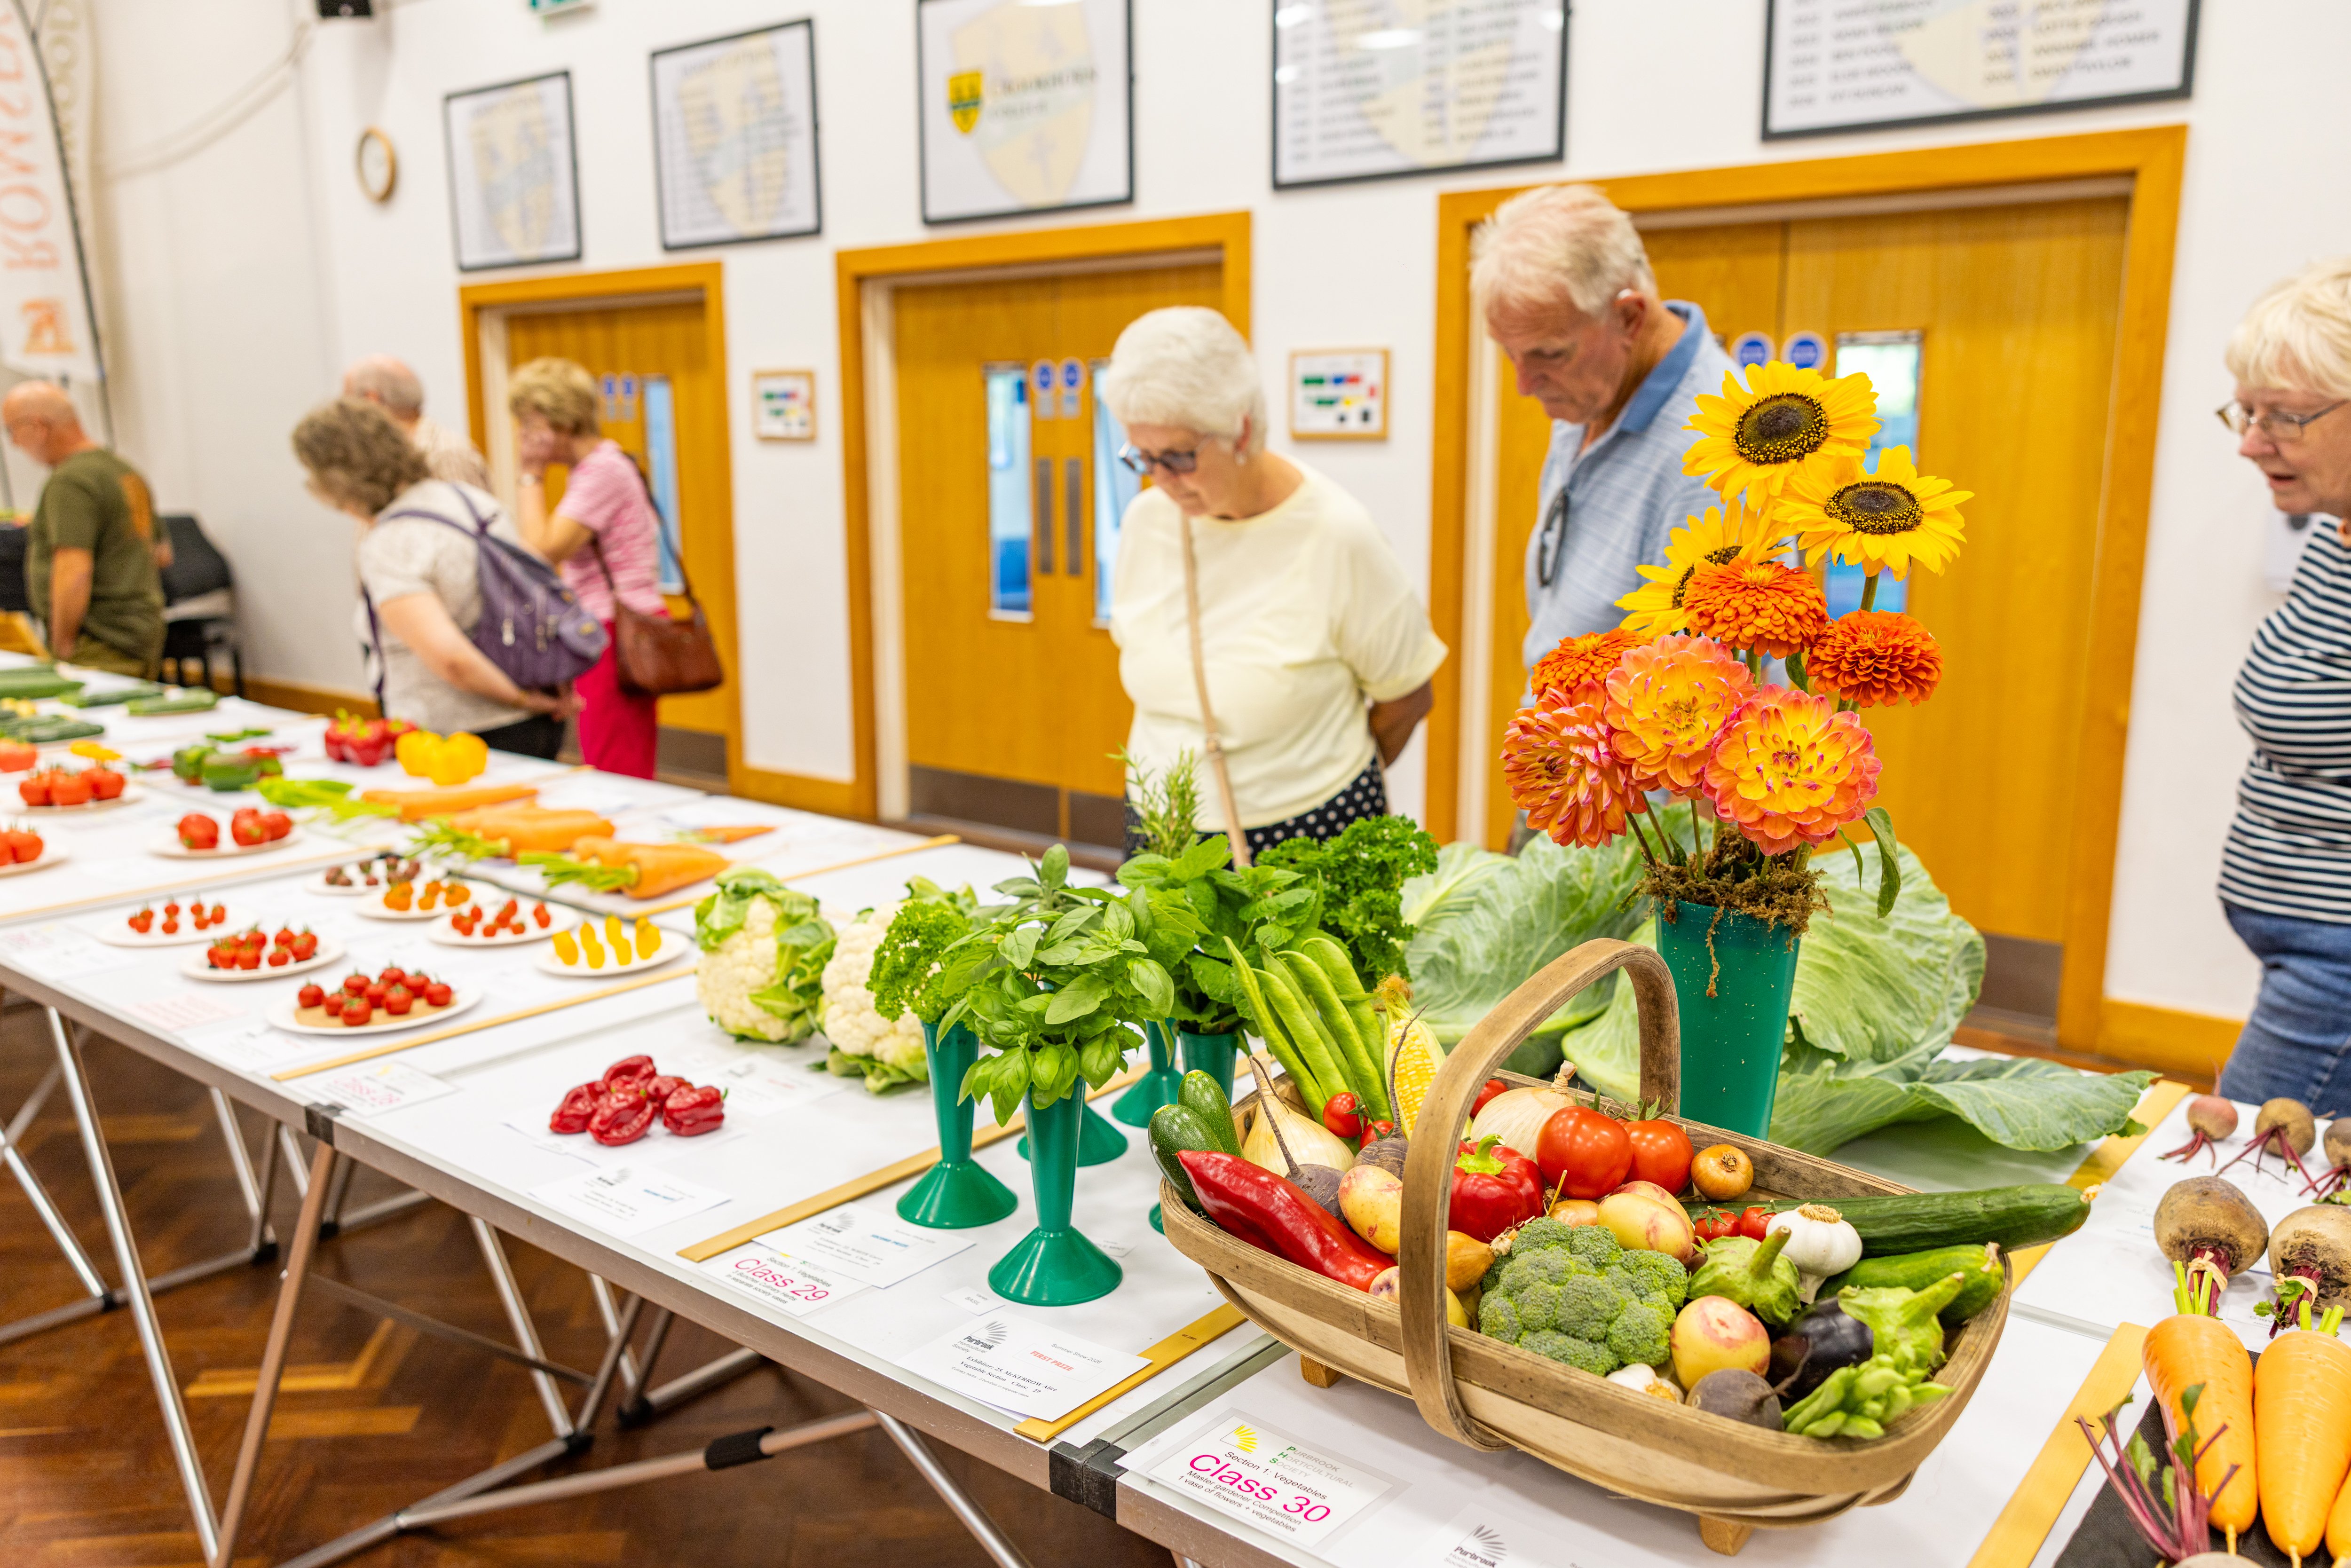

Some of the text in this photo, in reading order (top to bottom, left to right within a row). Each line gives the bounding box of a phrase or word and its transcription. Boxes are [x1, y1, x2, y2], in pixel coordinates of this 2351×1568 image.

[735, 1259, 829, 1300] Class 29
[736, 1272, 759, 1283] Bunches
[759, 1282, 780, 1293] Culinary
[779, 1291, 797, 1301] Herbs
[766, 1257, 790, 1268] Section
[797, 1269, 832, 1287] Vegetables
[731, 1276, 754, 1288] separate
[753, 1286, 772, 1297] society
[771, 1295, 788, 1304] vases
[952, 1344, 970, 1353] Society
[957, 1340, 988, 1354] Horticultural
[964, 1336, 995, 1350] Purbrook
[1051, 1343, 1073, 1354] Summer
[966, 1356, 994, 1369] Exhibitor:
[1003, 1370, 1042, 1387] McKERROW
[1030, 1350, 1074, 1371] FIRST PRIZE
[951, 1366, 966, 1375] Culinary
[982, 1378, 997, 1387] bunches
[1001, 1386, 1018, 1395] separate
[961, 1361, 986, 1374] Vegetable
[986, 1372, 1006, 1381] Section
[1011, 1381, 1028, 1390] Class:
[1269, 1458, 1311, 1478] SOCIETY
[1278, 1451, 1354, 1488] HORTICULTURAL
[1286, 1446, 1341, 1473] PURBROOK
[1190, 1454, 1331, 1522] Class 30
[1225, 1451, 1260, 1471] Section
[1273, 1472, 1328, 1500] Vegetables
[1184, 1480, 1204, 1490] vase
[1214, 1490, 1243, 1508] flowers
[1251, 1509, 1297, 1532] vegetables
[1186, 1470, 1302, 1526] Master gardener Competition
[1454, 1546, 1498, 1568] Purbrook
